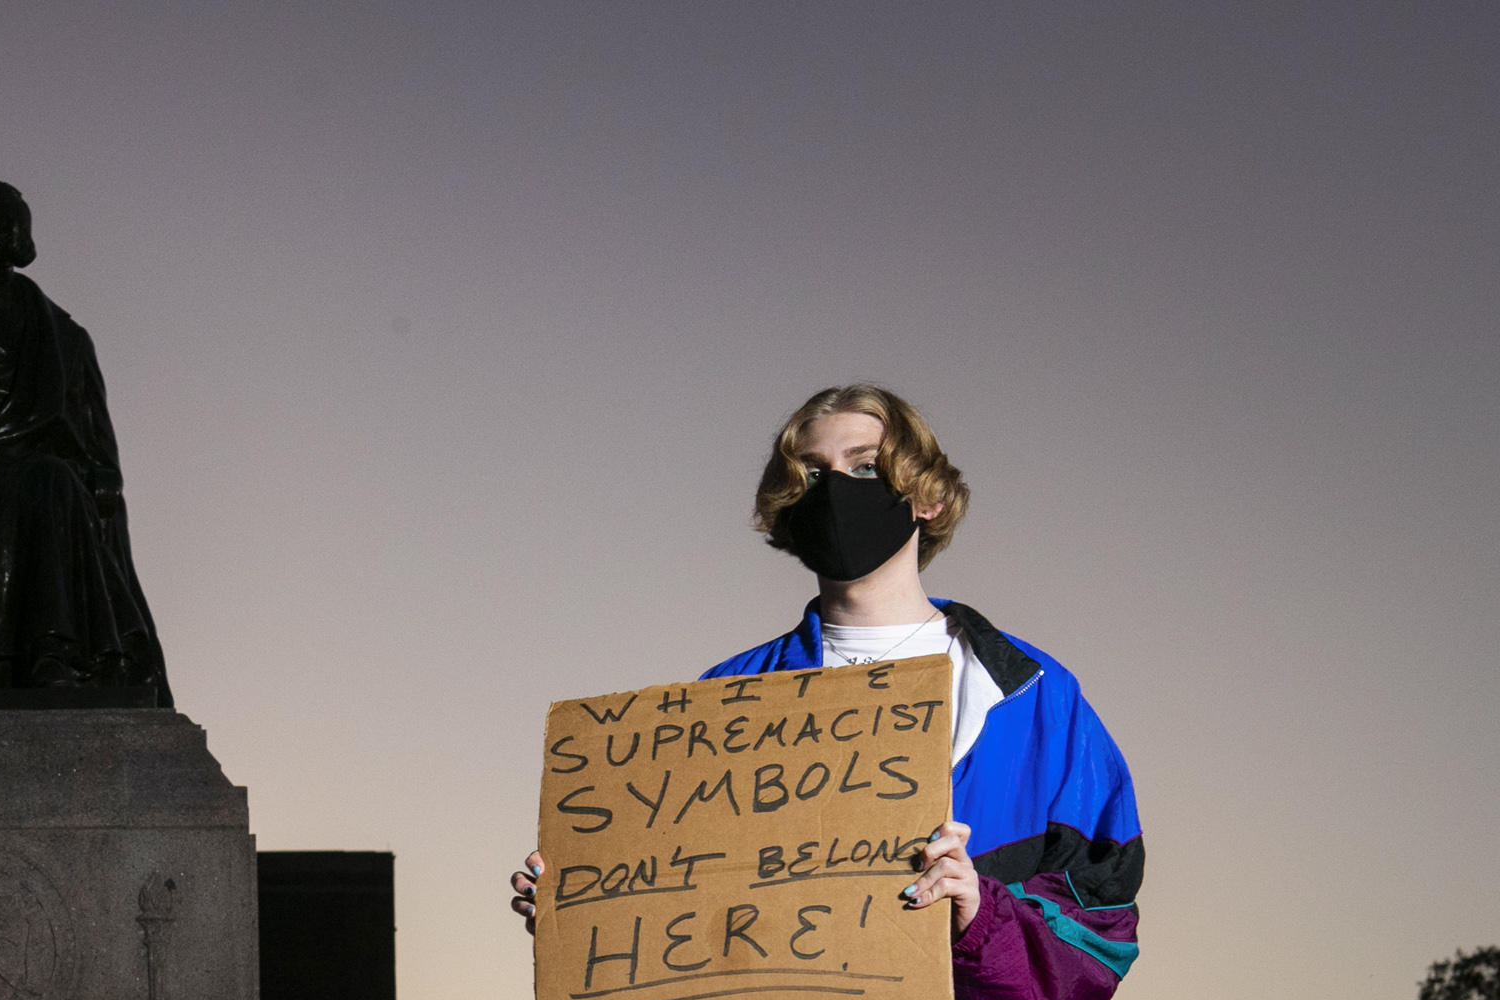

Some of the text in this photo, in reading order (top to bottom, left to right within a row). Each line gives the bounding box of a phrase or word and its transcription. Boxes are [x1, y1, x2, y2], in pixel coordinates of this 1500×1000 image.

[581, 662, 896, 724] WHITE
[550, 700, 944, 774] SUPREMACIST
[557, 750, 919, 833] SYMBOLS
[757, 835, 931, 879] BELONG
[584, 894, 873, 990] HERE!
